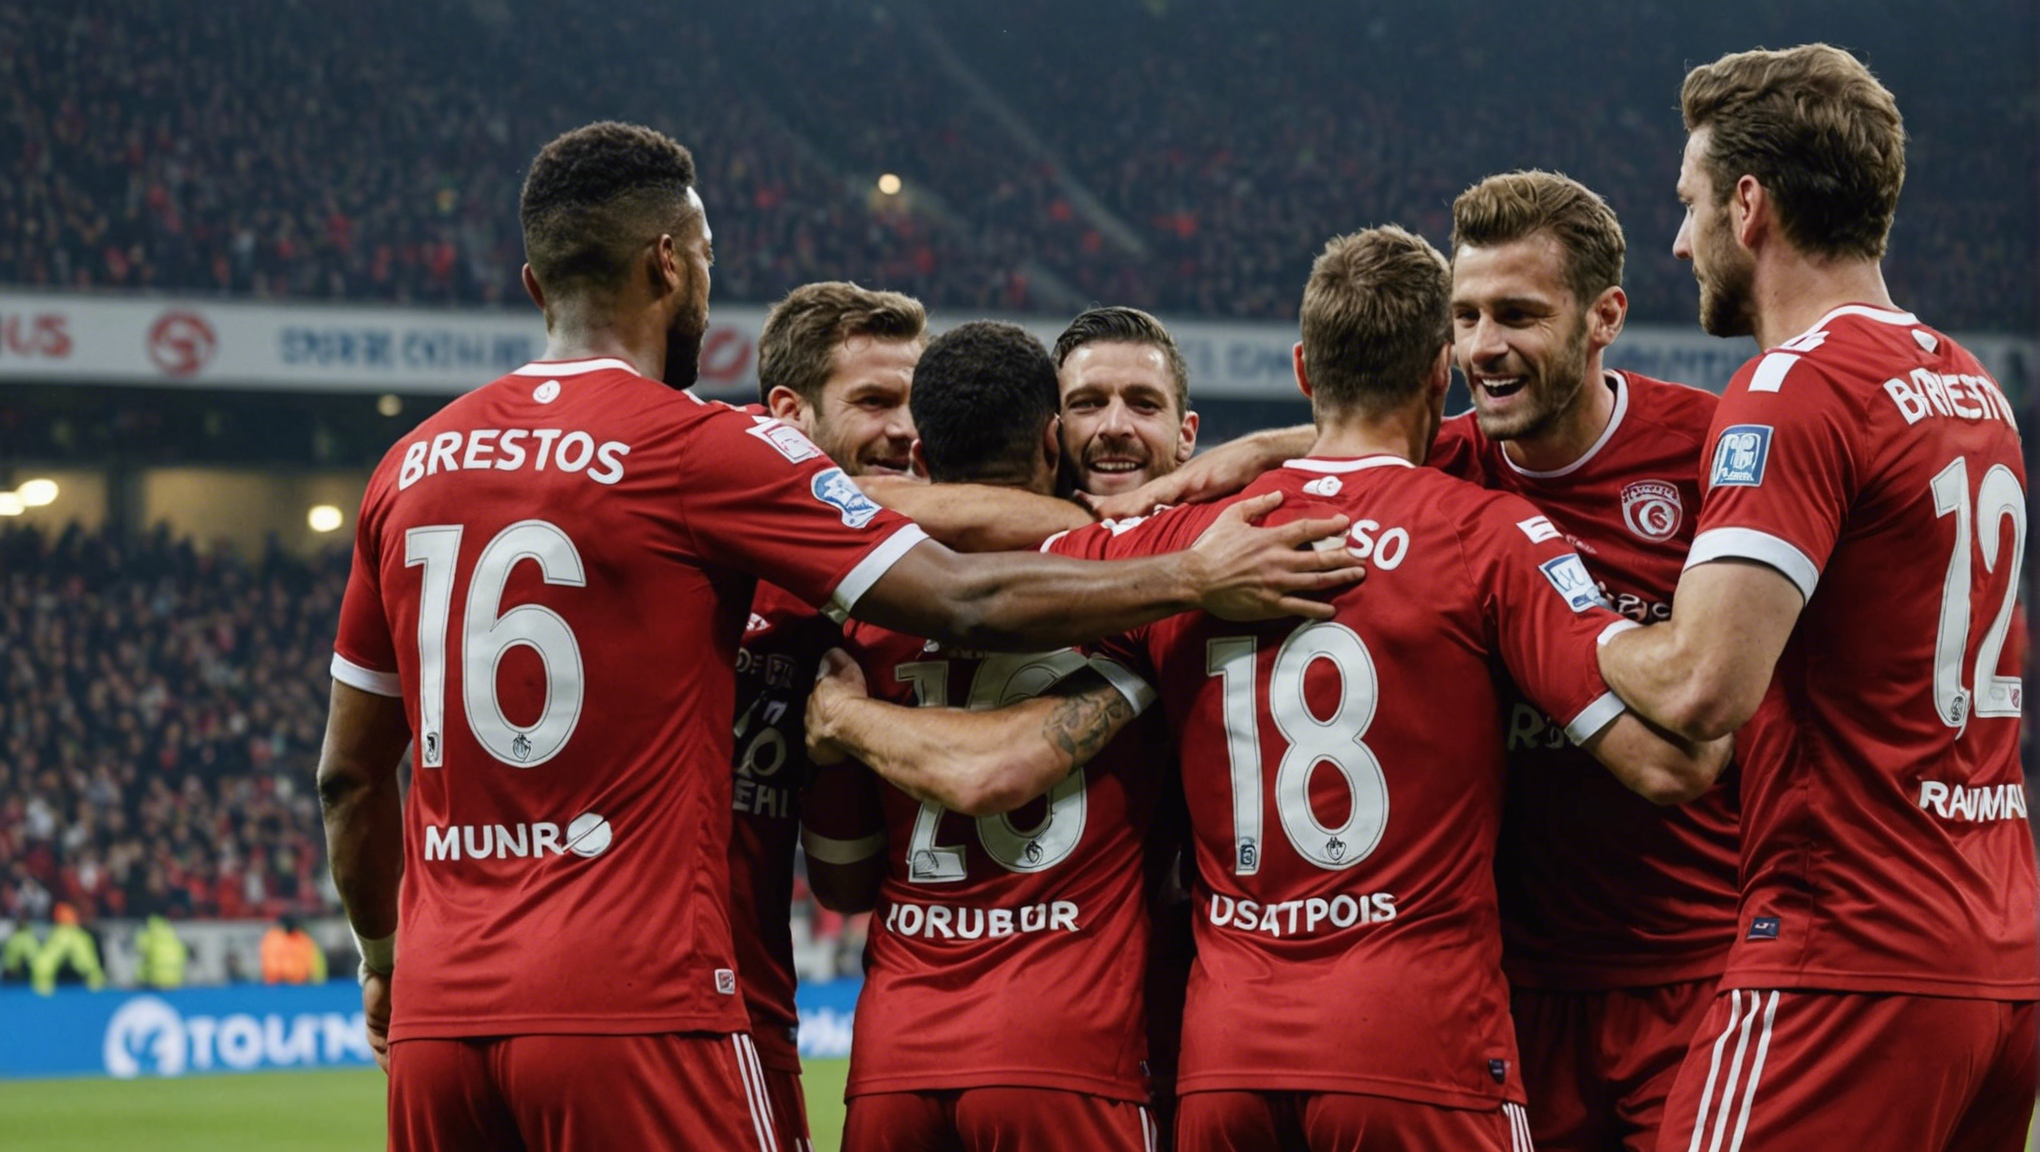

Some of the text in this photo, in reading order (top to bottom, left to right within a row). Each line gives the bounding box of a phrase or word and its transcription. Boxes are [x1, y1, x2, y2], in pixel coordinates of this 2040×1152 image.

[398, 428, 632, 492] BRESTOS
[404, 518, 588, 770] 16
[1930, 456, 2027, 732] 12
[1205, 621, 1390, 876] 18
